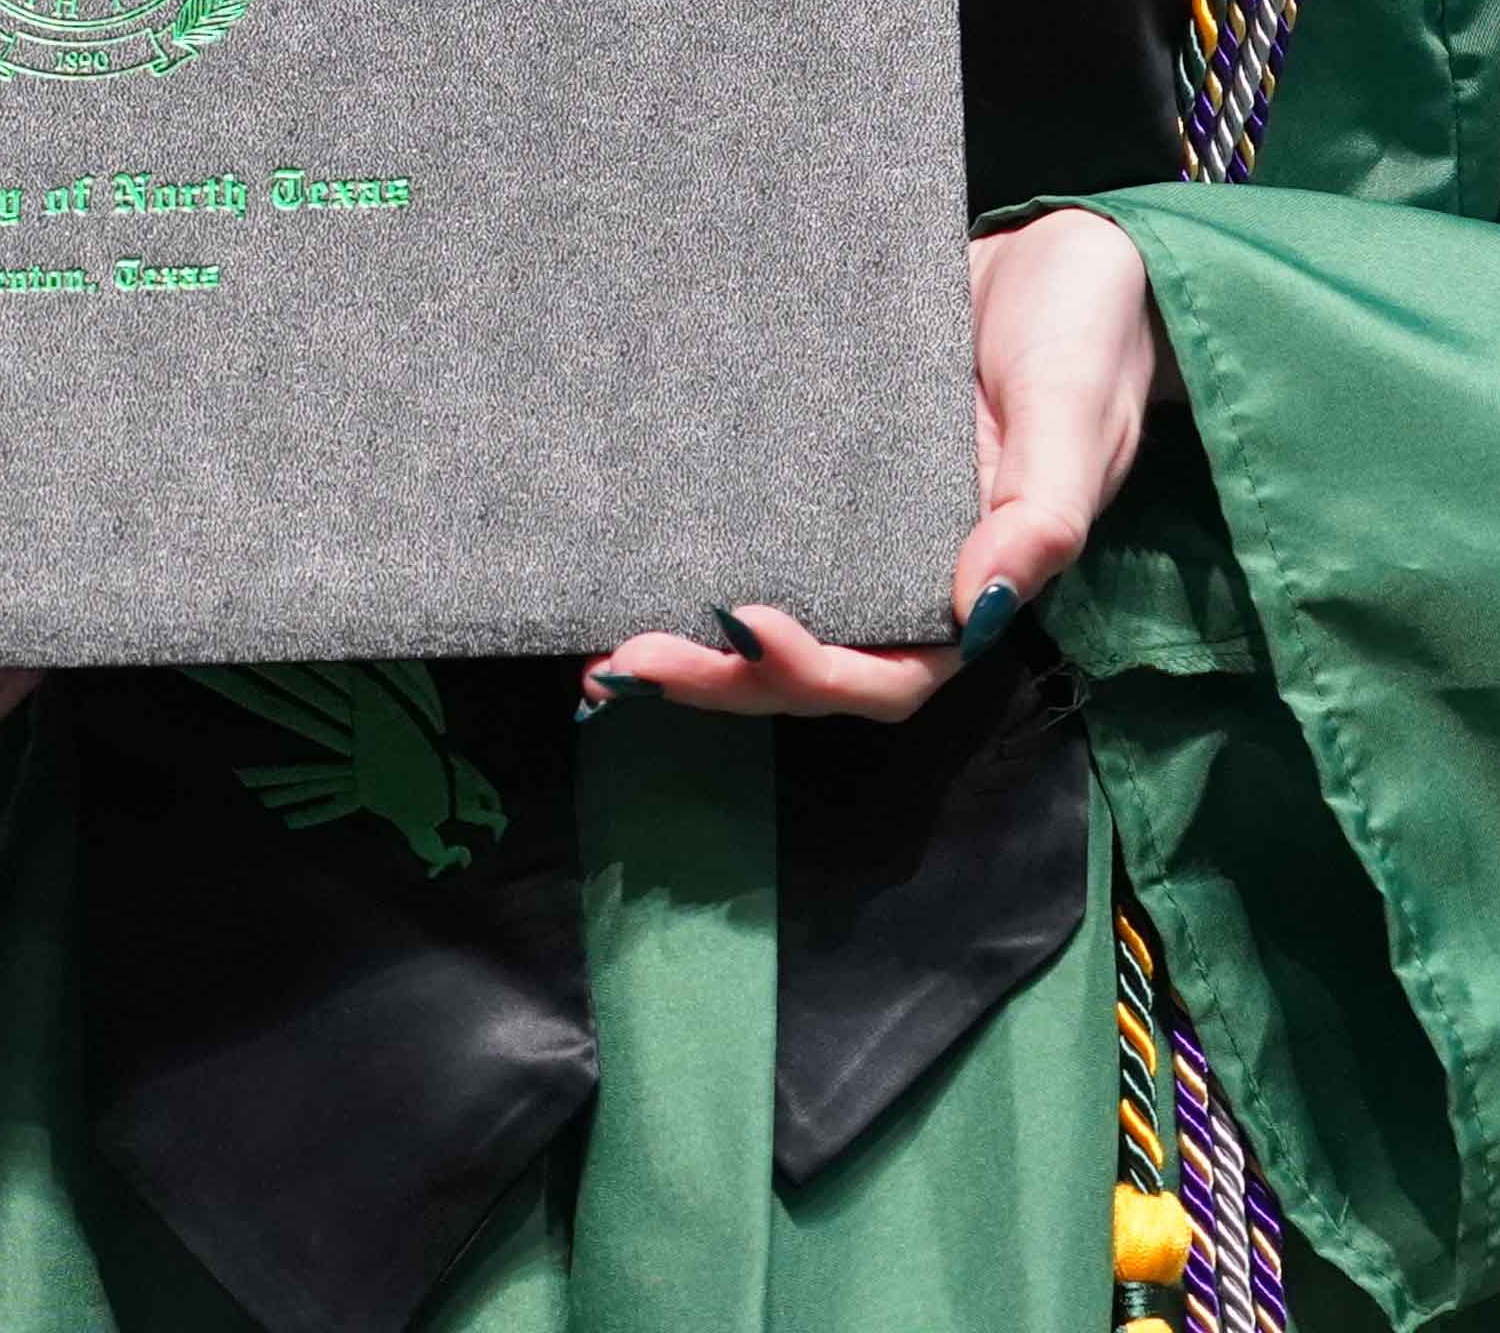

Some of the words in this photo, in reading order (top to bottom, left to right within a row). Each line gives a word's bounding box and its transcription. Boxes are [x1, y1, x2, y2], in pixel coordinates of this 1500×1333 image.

[40, 173, 98, 218] of
[112, 171, 249, 221] North
[269, 167, 414, 211] Texas
[113, 257, 222, 292] Texas
